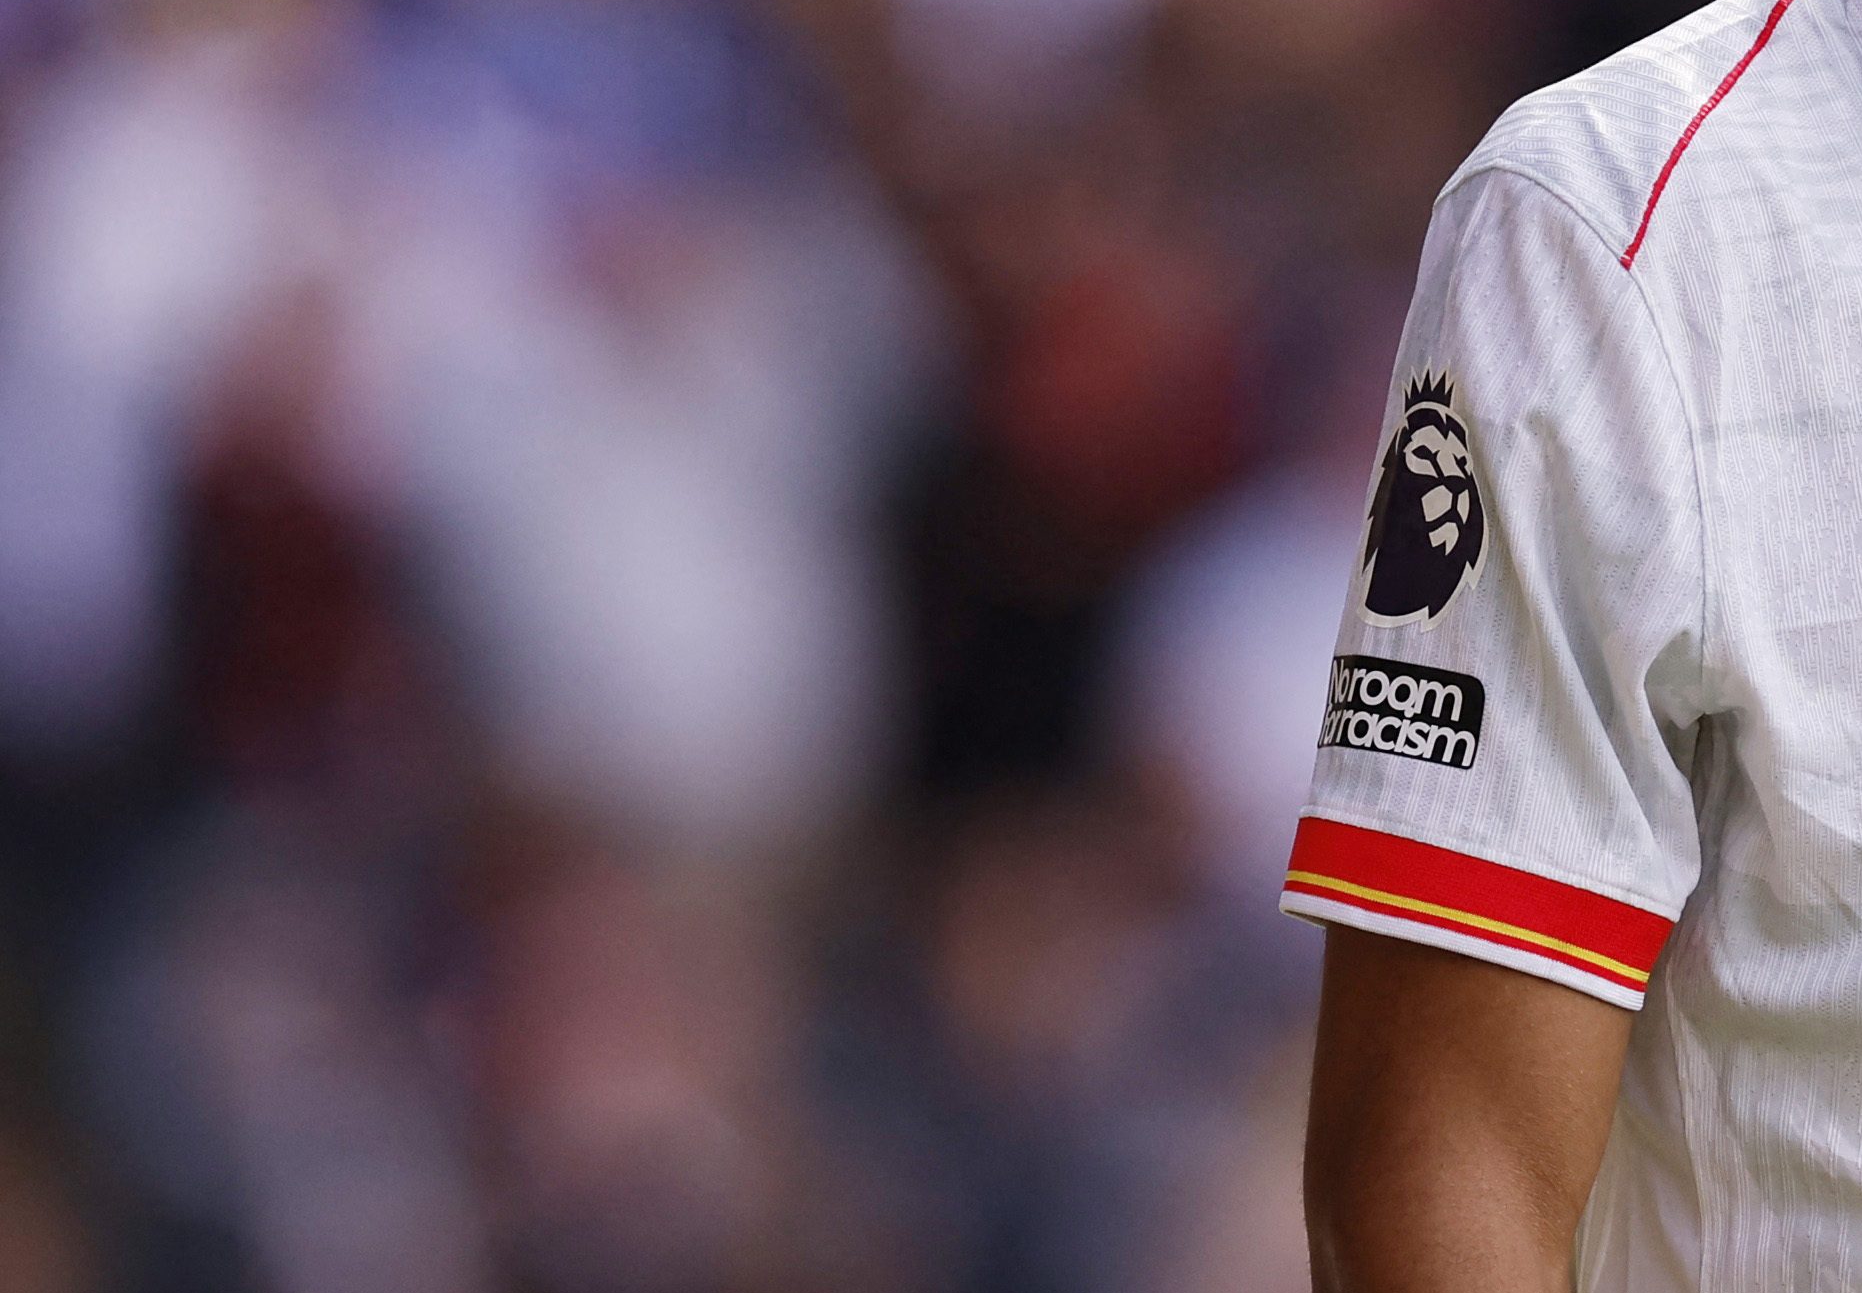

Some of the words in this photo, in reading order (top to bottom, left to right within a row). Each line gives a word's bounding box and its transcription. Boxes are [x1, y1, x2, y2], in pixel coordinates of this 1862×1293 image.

[1329, 659, 1350, 704] No
[1347, 668, 1463, 722] room
[1335, 708, 1476, 767] racism
